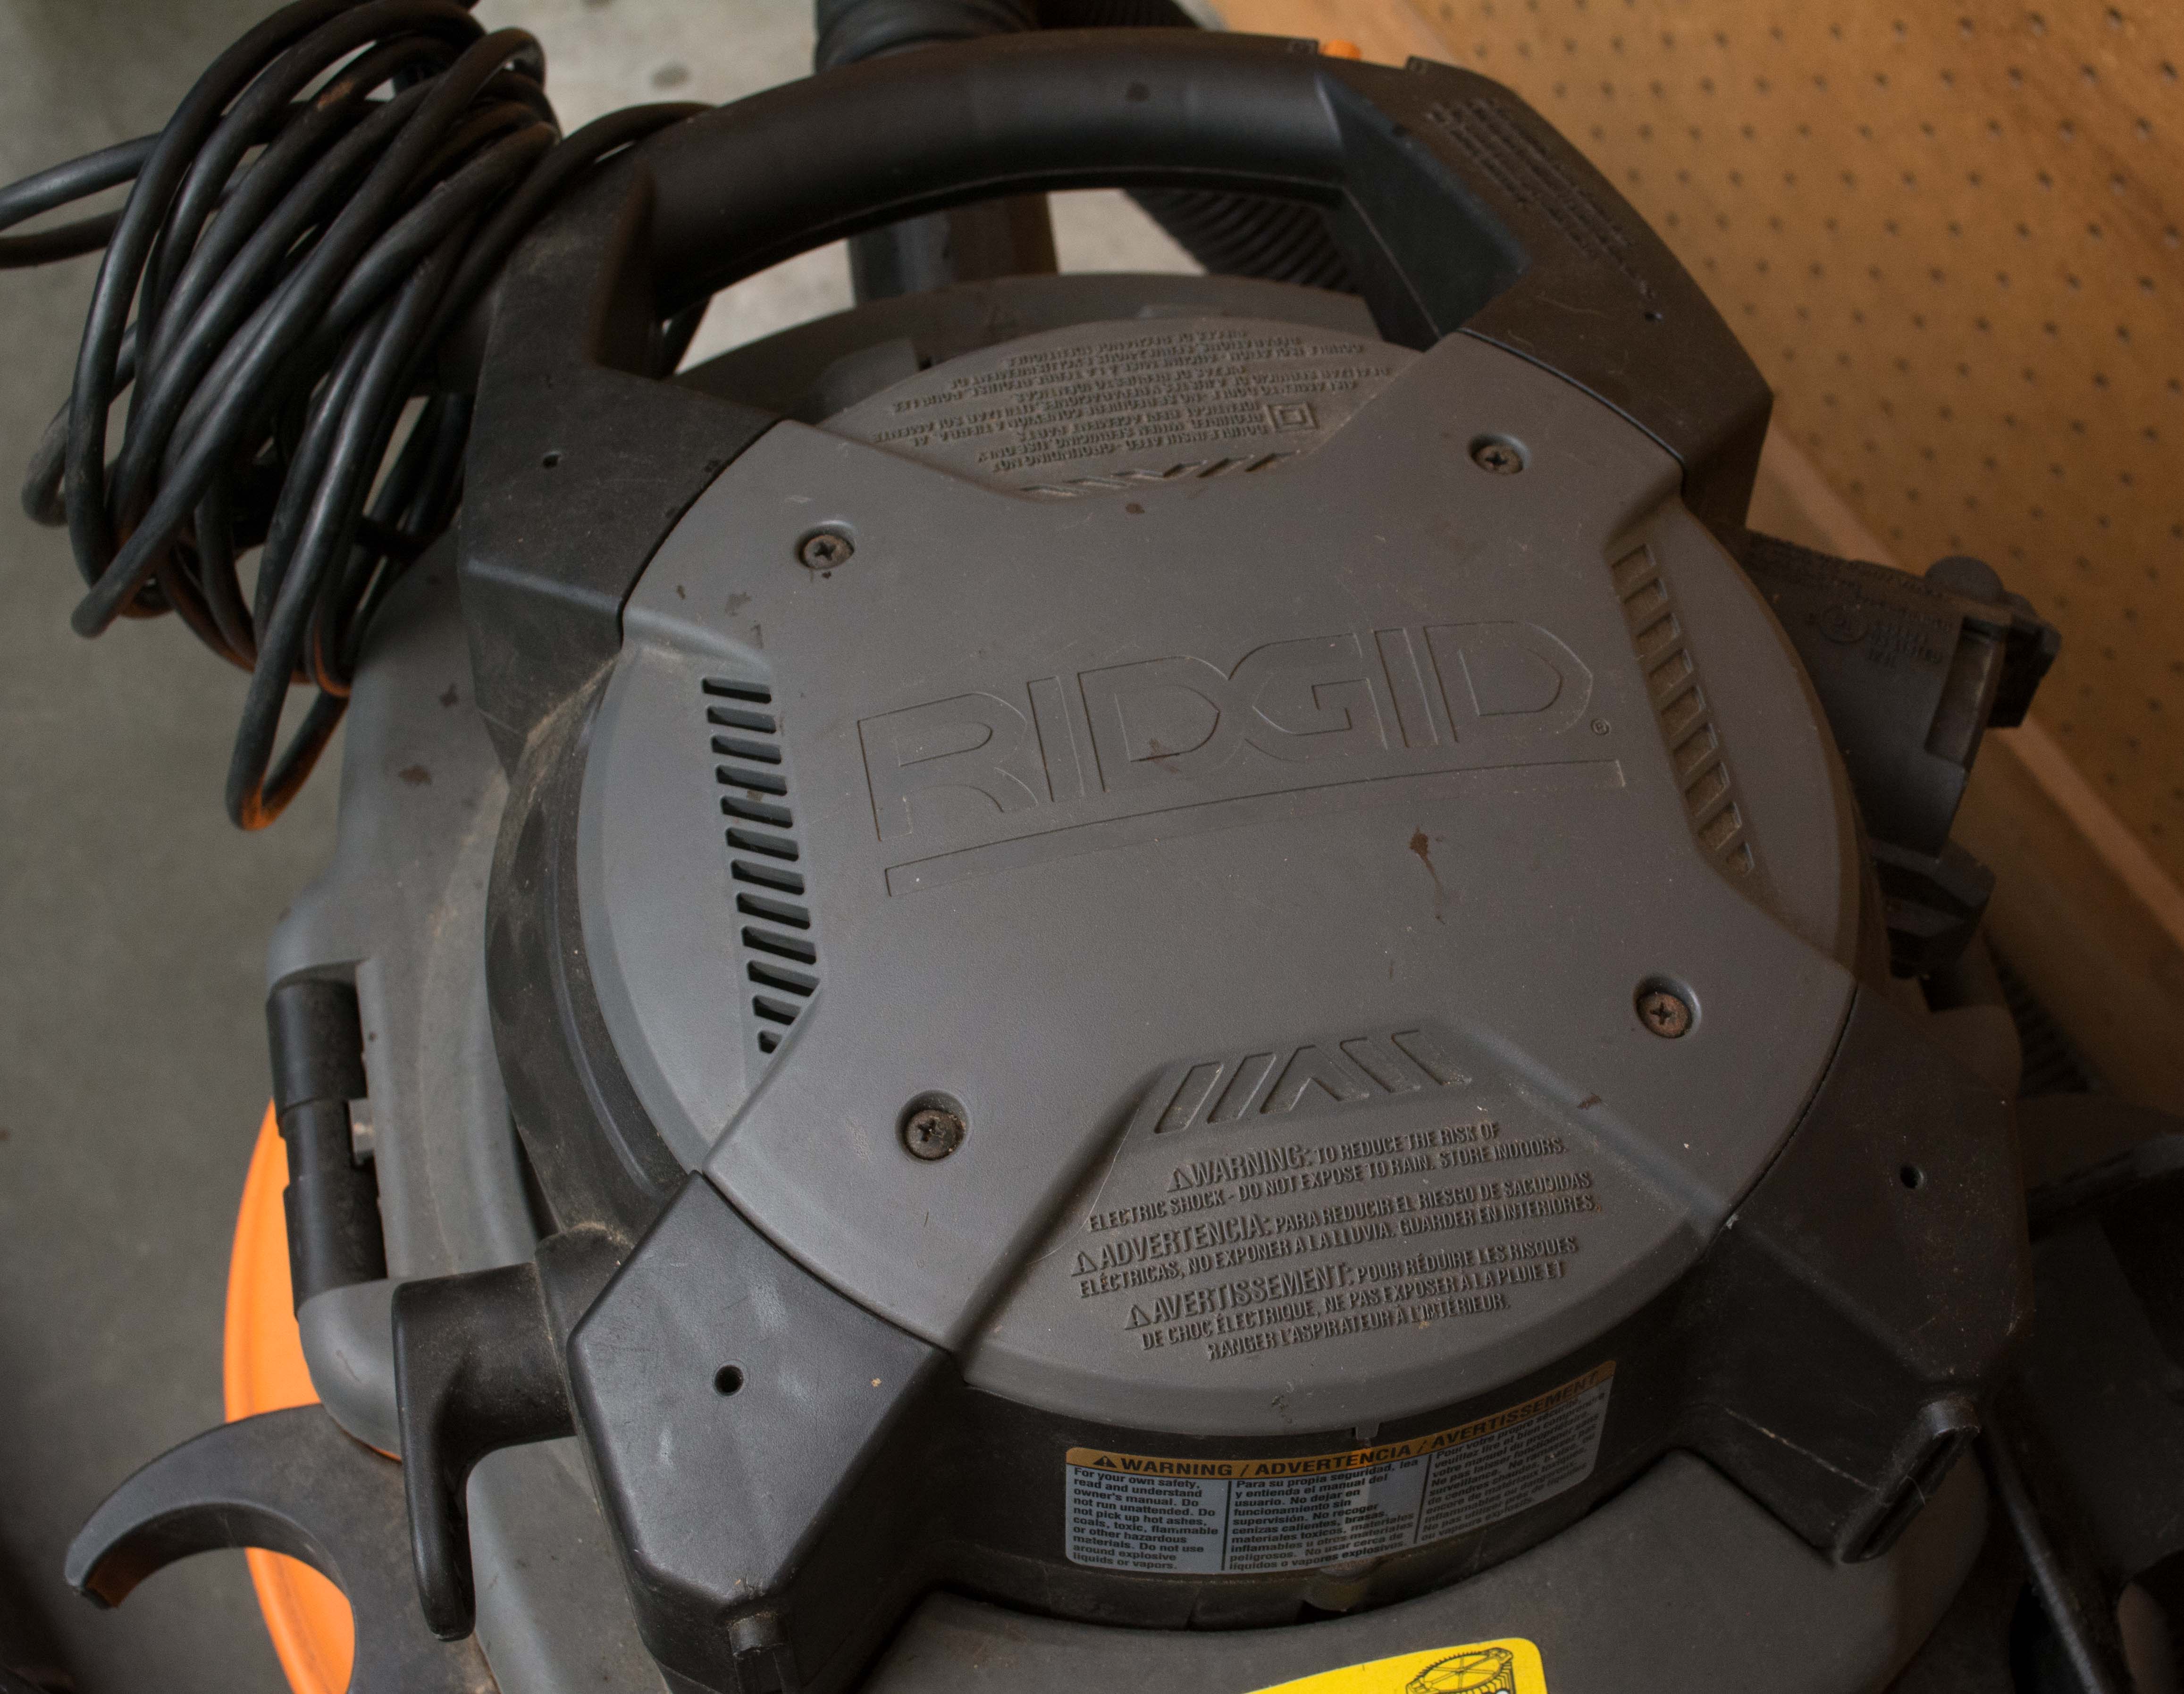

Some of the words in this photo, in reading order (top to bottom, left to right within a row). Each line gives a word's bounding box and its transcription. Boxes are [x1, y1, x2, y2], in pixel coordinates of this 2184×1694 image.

[857, 621, 1594, 842] RIDGID
[1189, 1144, 1313, 1188] WARNING:
[1315, 1146, 1337, 1165] TO
[1340, 1136, 1403, 1161] REDUCE
[1406, 1131, 1436, 1150] THE
[1440, 1126, 1477, 1147] RISK
[1479, 1121, 1499, 1141] OF
[1088, 1201, 1168, 1233] ELECTRIC
[1169, 1189, 1226, 1216] SHOCK
[1239, 1182, 1261, 1202] DO
[1264, 1177, 1297, 1197] NOT
[1300, 1164, 1363, 1191] EXPOSE
[1365, 1160, 1387, 1179] TO
[1389, 1155, 1435, 1176] RAIN.
[1440, 1146, 1492, 1169] STORE
[1493, 1137, 1567, 1162] INDOORS.
[1100, 1213, 1271, 1270] ADVERTENCIA:
[1274, 1210, 1319, 1234] PARA
[1321, 1199, 1394, 1225] REDUCIR
[1394, 1194, 1416, 1213] EL
[1417, 1185, 1477, 1210] RIESGO
[1478, 1182, 1502, 1200] DE
[1503, 1171, 1592, 1198] SACUDIDAS
[1186, 1254, 1211, 1275] NO
[1215, 1235, 1292, 1269] EXPONER
[1294, 1235, 1306, 1253] A
[1308, 1230, 1331, 1252] LA
[1332, 1222, 1397, 1247] LLUVIA.
[1399, 1209, 1477, 1236] GUARDER
[1478, 1204, 1502, 1225] EN
[1153, 1262, 1354, 1323] AVERTISSEMENT:
[1356, 1260, 1403, 1284] POUR
[1476, 1245, 1507, 1265] LES
[1510, 1235, 1579, 1261] RISQUES
[1142, 1329, 1163, 1350] DE
[1167, 1320, 1213, 1344] CHOC
[1323, 1293, 1345, 1313] NE
[1349, 1288, 1380, 1309] PAS
[1381, 1275, 1458, 1303] EXPOSER
[1473, 1271, 1495, 1290] LA
[1496, 1264, 1543, 1285] PLUIE
[1545, 1260, 1566, 1279] ET
[1208, 1331, 1277, 1361] RANGER
[1281, 1310, 1395, 1346] L'ASPIRATEUR
[1121, 1458, 1233, 1476] WARNING
[1255, 1445, 1411, 1475] ADVERTENCIA
[1432, 1372, 1596, 1449] AVERTISSEMENT
[1075, 1467, 1095, 1477] For
[1098, 1472, 1125, 1482] your
[1159, 1479, 1200, 1489] safety,
[1287, 1476, 1327, 1488] propia
[1400, 1459, 1418, 1468] lea
[1075, 1478, 1101, 1488] read
[1106, 1483, 1128, 1492] and
[1133, 1486, 1202, 1497] understand
[1246, 1487, 1300, 1497] entienda
[1319, 1478, 1366, 1492] manual
[1369, 1474, 1388, 1484] del
[1074, 1488, 1122, 1501] owner's
[1126, 1494, 1176, 1506] manual.
[1310, 1491, 1343, 1502] dejar
[1074, 1498, 1092, 1506] not
[1097, 1501, 1117, 1510] run
[1120, 1504, 1193, 1516] unattended.
[1235, 1502, 1330, 1516] funcionamiento
[1333, 1500, 1351, 1508] sin
[1313, 1511, 1329, 1520] No
[1333, 1504, 1378, 1518] recoger
[1074, 1508, 1092, 1516] not
[1096, 1511, 1121, 1521] pick
[1125, 1514, 1139, 1523] up
[1143, 1515, 1163, 1524] hot
[1167, 1517, 1206, 1526] ashes,
[1074, 1517, 1110, 1528] coals,
[1114, 1521, 1147, 1533] toxic,
[1152, 1526, 1218, 1535] flammable
[1089, 1528, 1119, 1538] other
[1124, 1532, 1187, 1543] hazardous
[1231, 1533, 1297, 1543] materiales
[1351, 1513, 1414, 1531] materiales
[1231, 1542, 1303, 1552] inflamables
[1317, 1536, 1349, 1545] otros
[1350, 1522, 1413, 1539] materiales
[1233, 1525, 1280, 1534] cenizas
[1073, 1535, 1134, 1549] materials.
[1160, 1543, 1178, 1551] not
[1324, 1543, 1351, 1552] usar
[1354, 1536, 1386, 1547] cerca
[1073, 1545, 1115, 1556] around
[1118, 1551, 1176, 1562] explosive
[1073, 1552, 1114, 1564] liquids
[1133, 1560, 1177, 1570] vapors.
[1292, 1553, 1339, 1566] vapores
